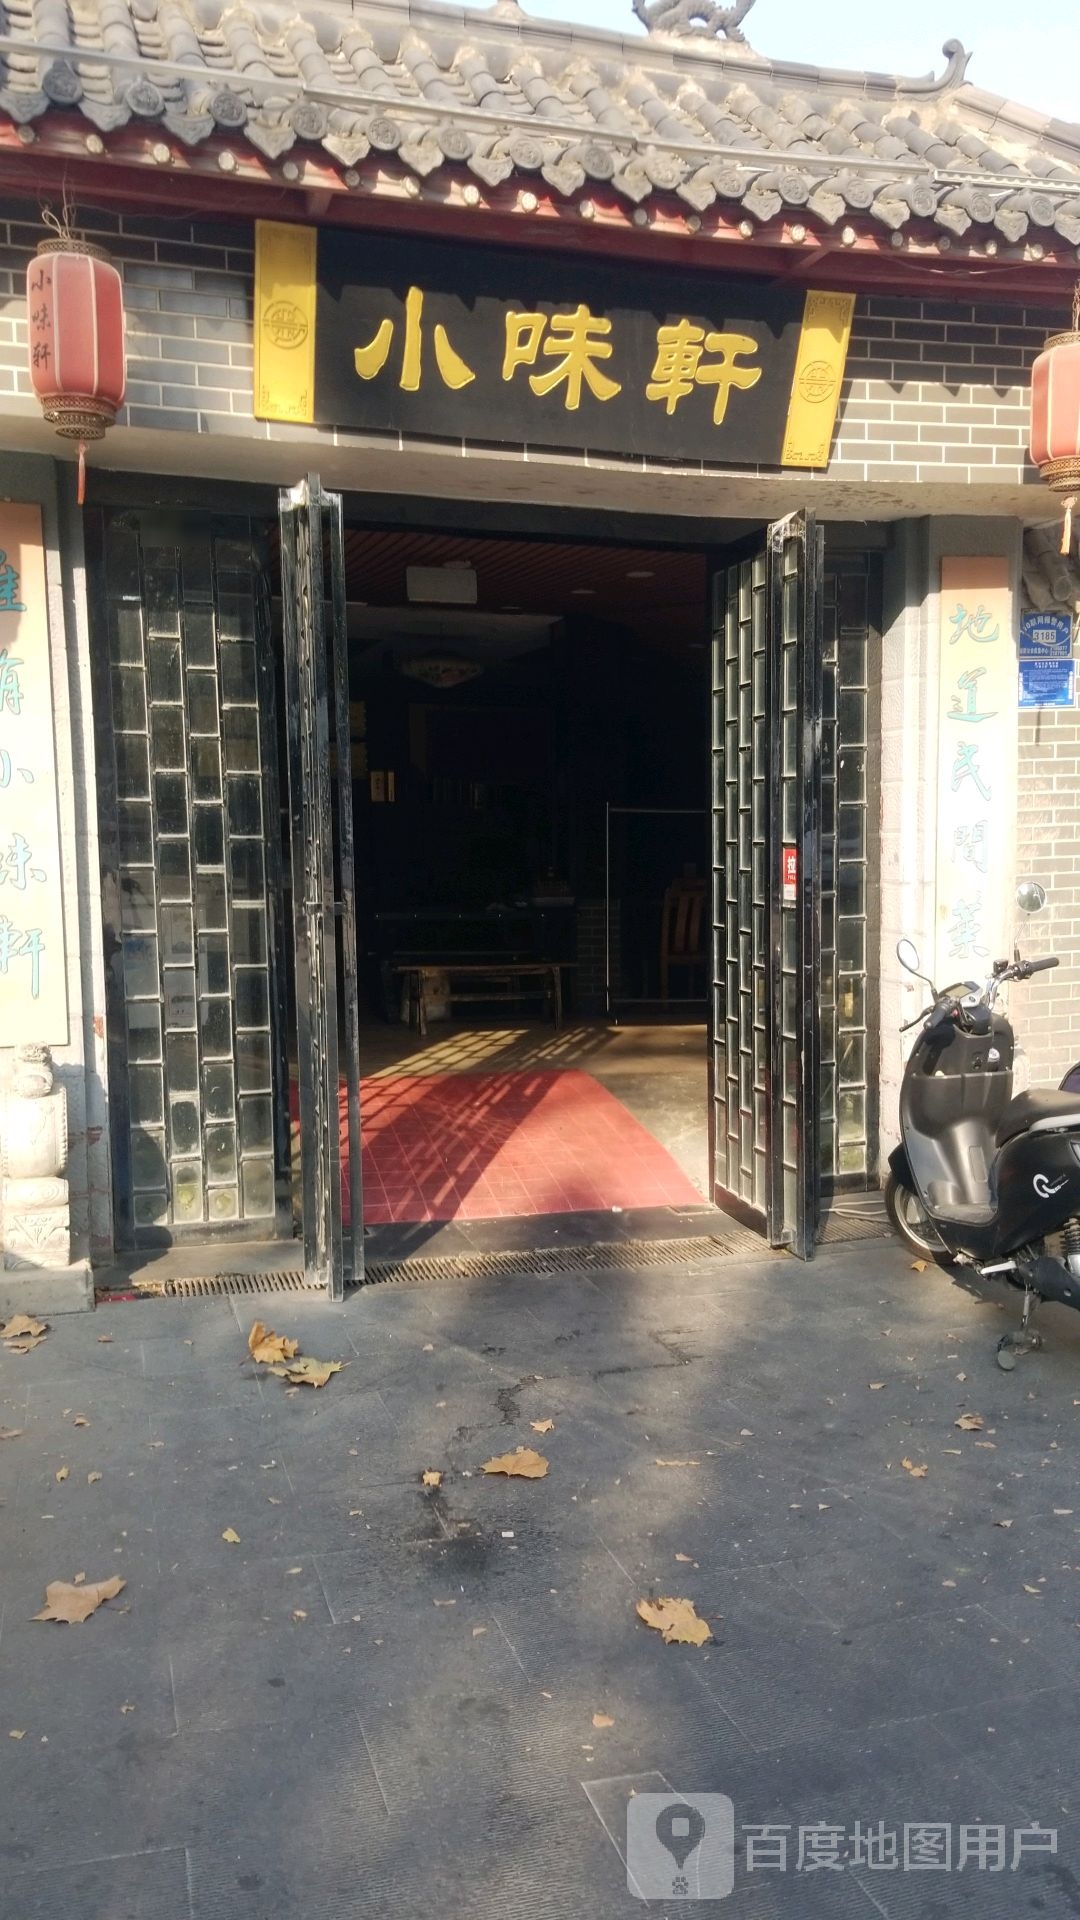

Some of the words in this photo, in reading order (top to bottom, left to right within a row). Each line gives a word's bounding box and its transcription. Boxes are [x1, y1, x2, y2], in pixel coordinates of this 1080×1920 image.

[354, 286, 763, 425] 小味軒
[1033, 631, 1056, 641] 3185
